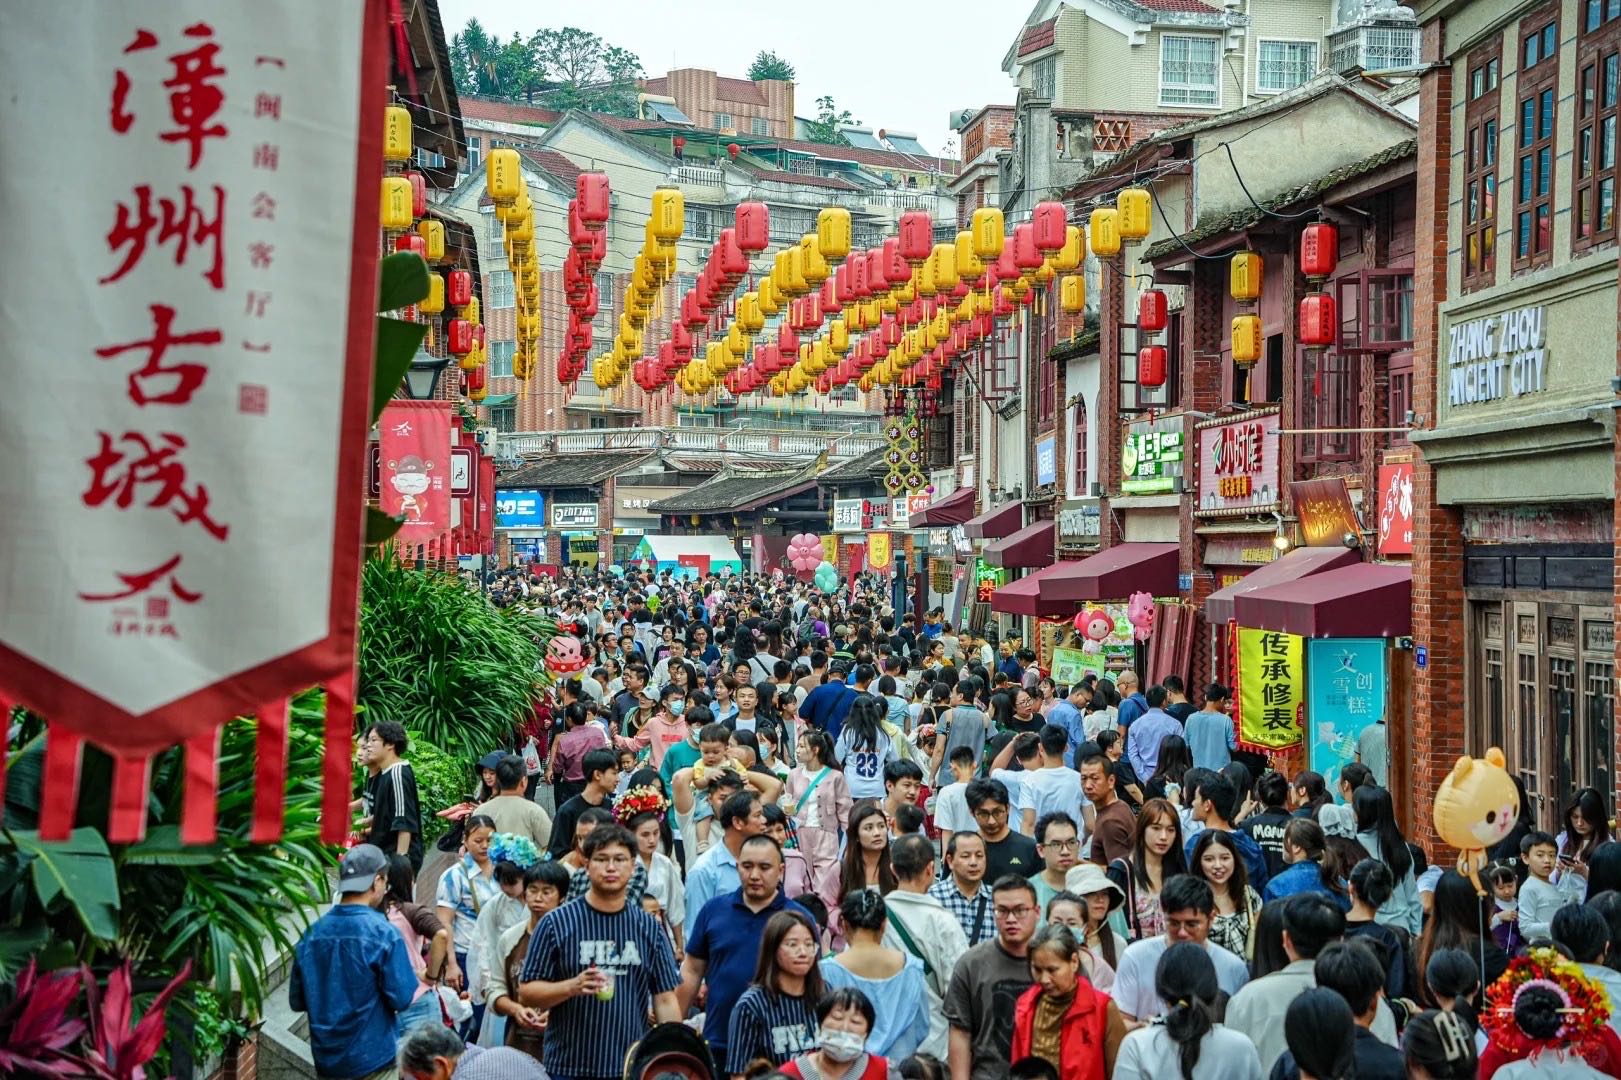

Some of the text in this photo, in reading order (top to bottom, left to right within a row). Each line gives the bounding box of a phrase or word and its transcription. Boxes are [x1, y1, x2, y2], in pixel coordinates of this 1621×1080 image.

[83, 23, 229, 540] 漳州古城
[1449, 306, 1545, 364] ZHANG ZHOU
[1449, 349, 1545, 406] ANCIENT CITY
[1260, 633, 1292, 731] 传承修表
[856, 752, 877, 778] 23
[580, 940, 641, 966] FILA
[771, 1024, 818, 1055] FIL
